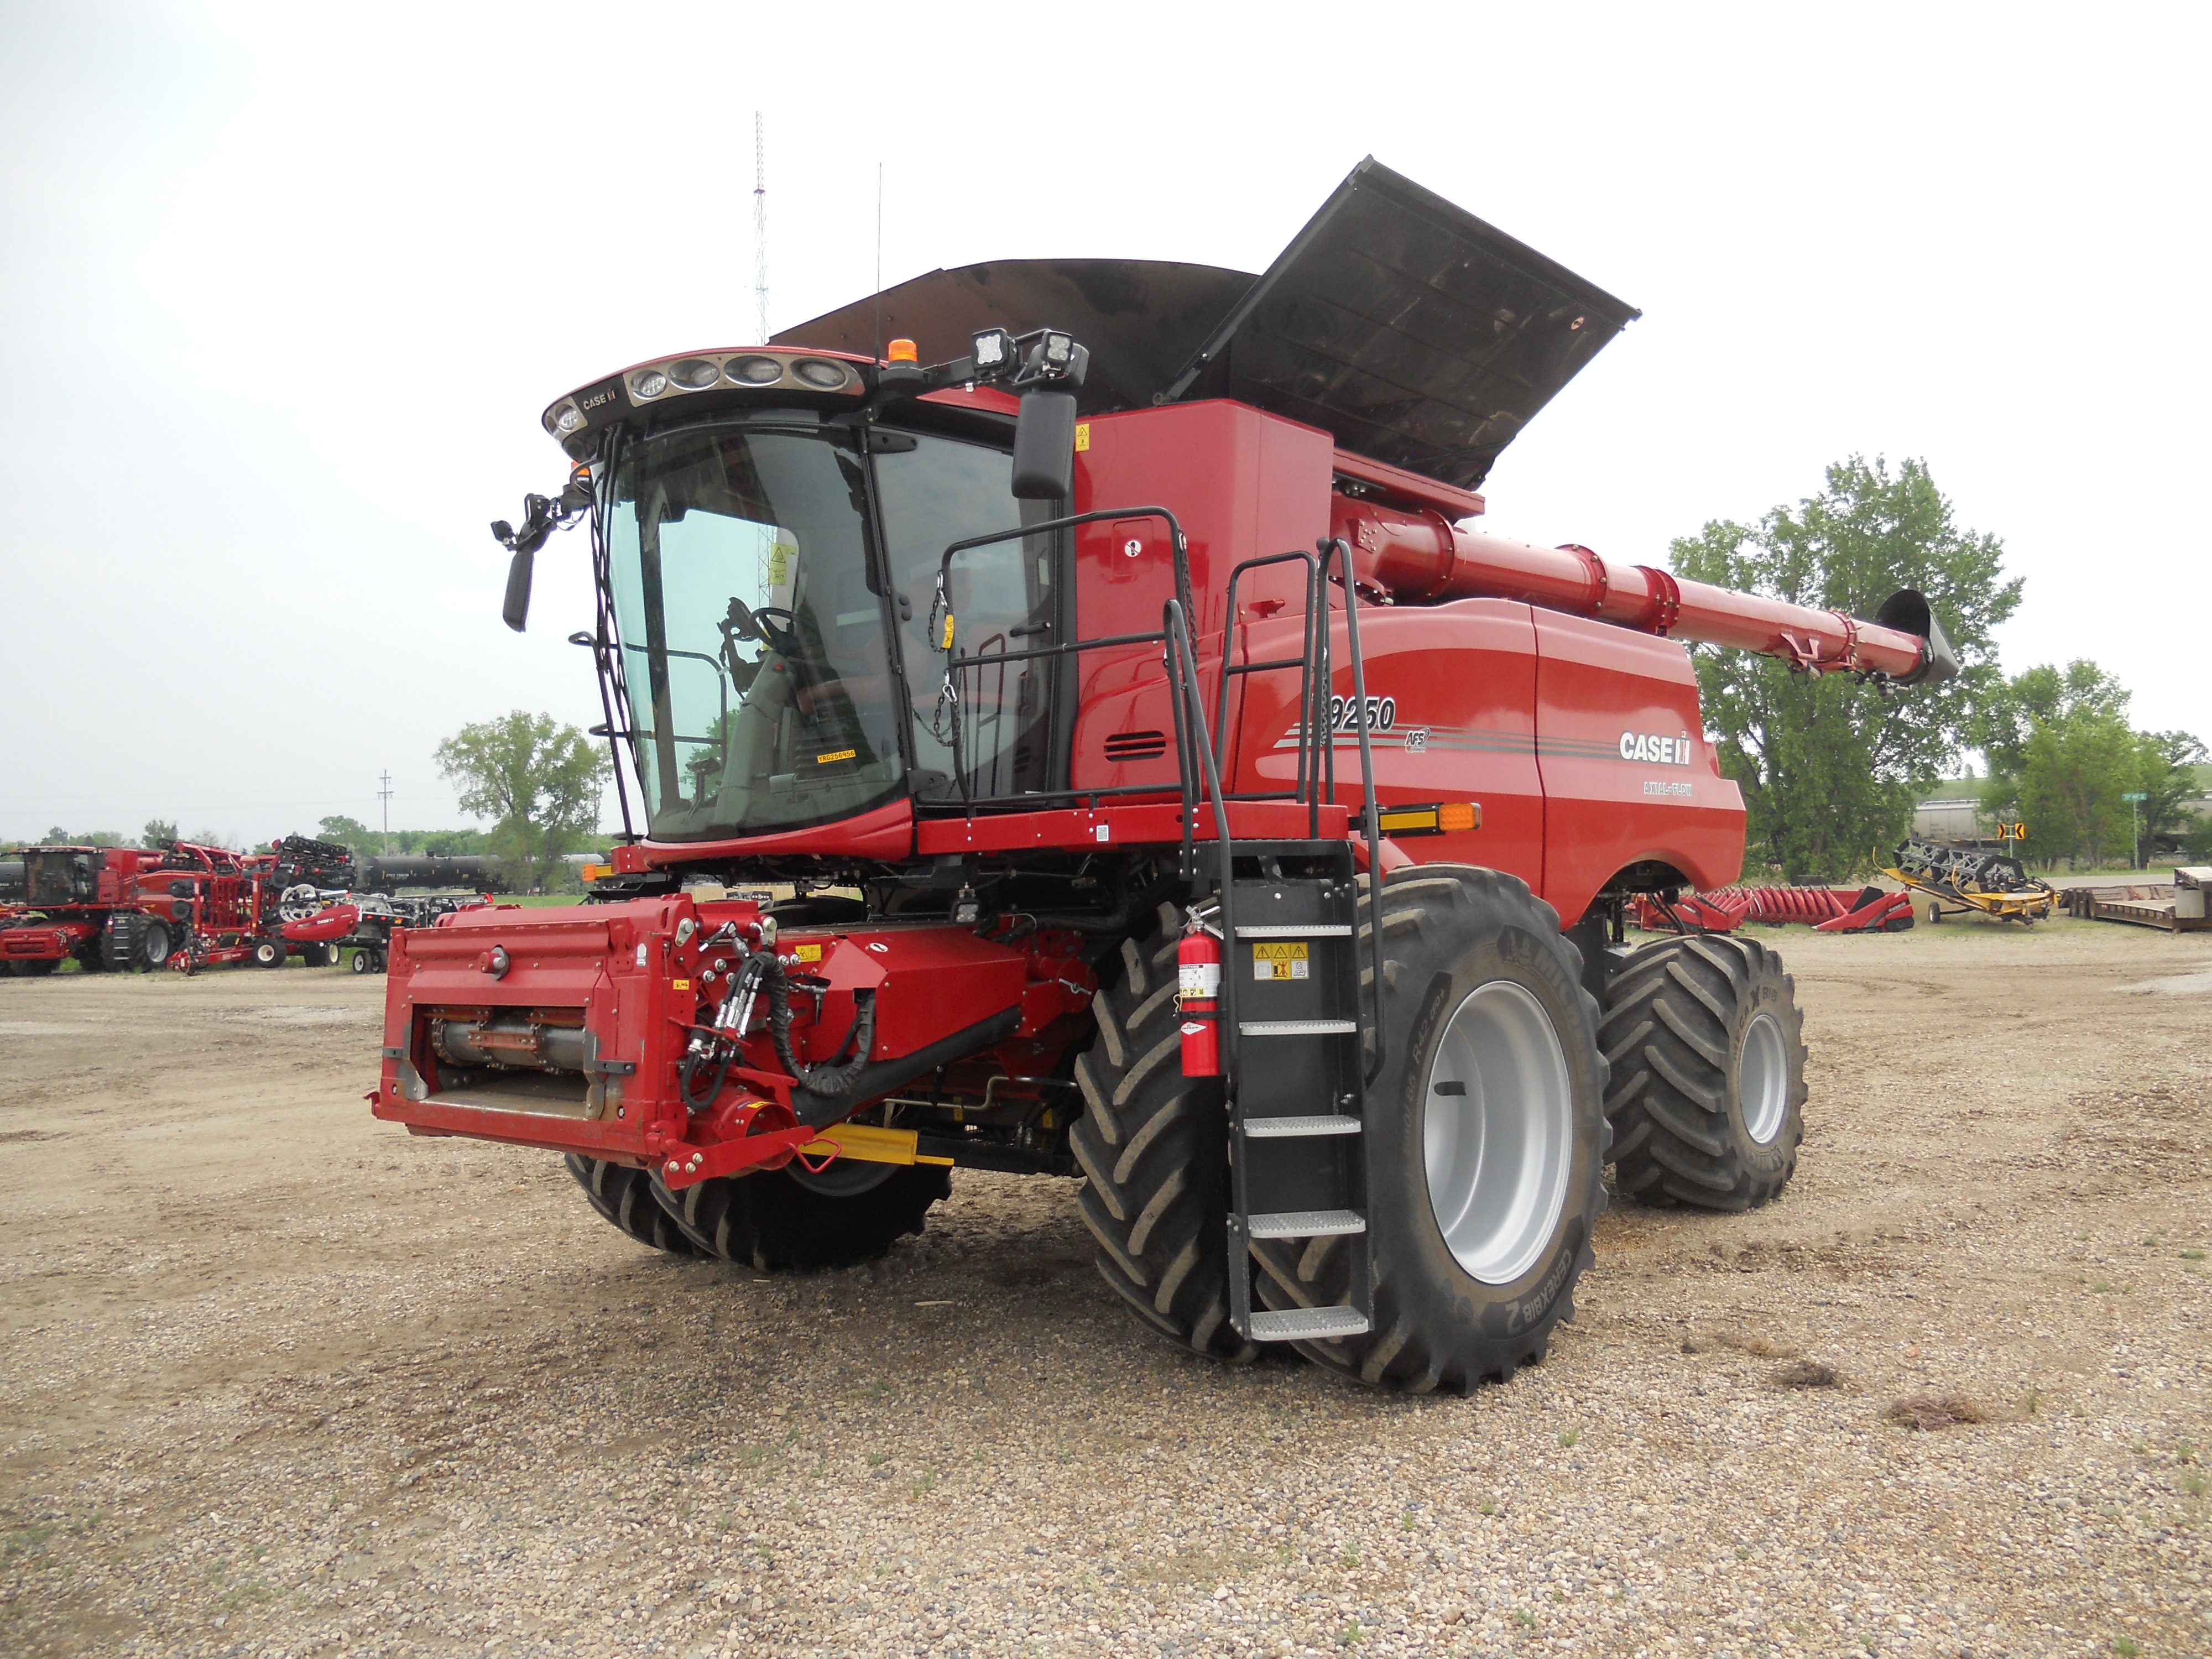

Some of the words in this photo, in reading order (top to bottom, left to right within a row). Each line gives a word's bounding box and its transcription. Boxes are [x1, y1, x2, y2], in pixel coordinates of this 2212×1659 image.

[583, 394, 607, 410] CASE
[1331, 695, 1396, 732] 9250
[1405, 731, 1425, 745] AFS
[1620, 732, 1673, 763] CASE
[818, 750, 855, 762] YRG256956
[1644, 781, 1692, 796] AXIAL-FLOW
[1522, 1248, 1572, 1323] CEREXBIB
[1505, 1301, 1521, 1335] 2
